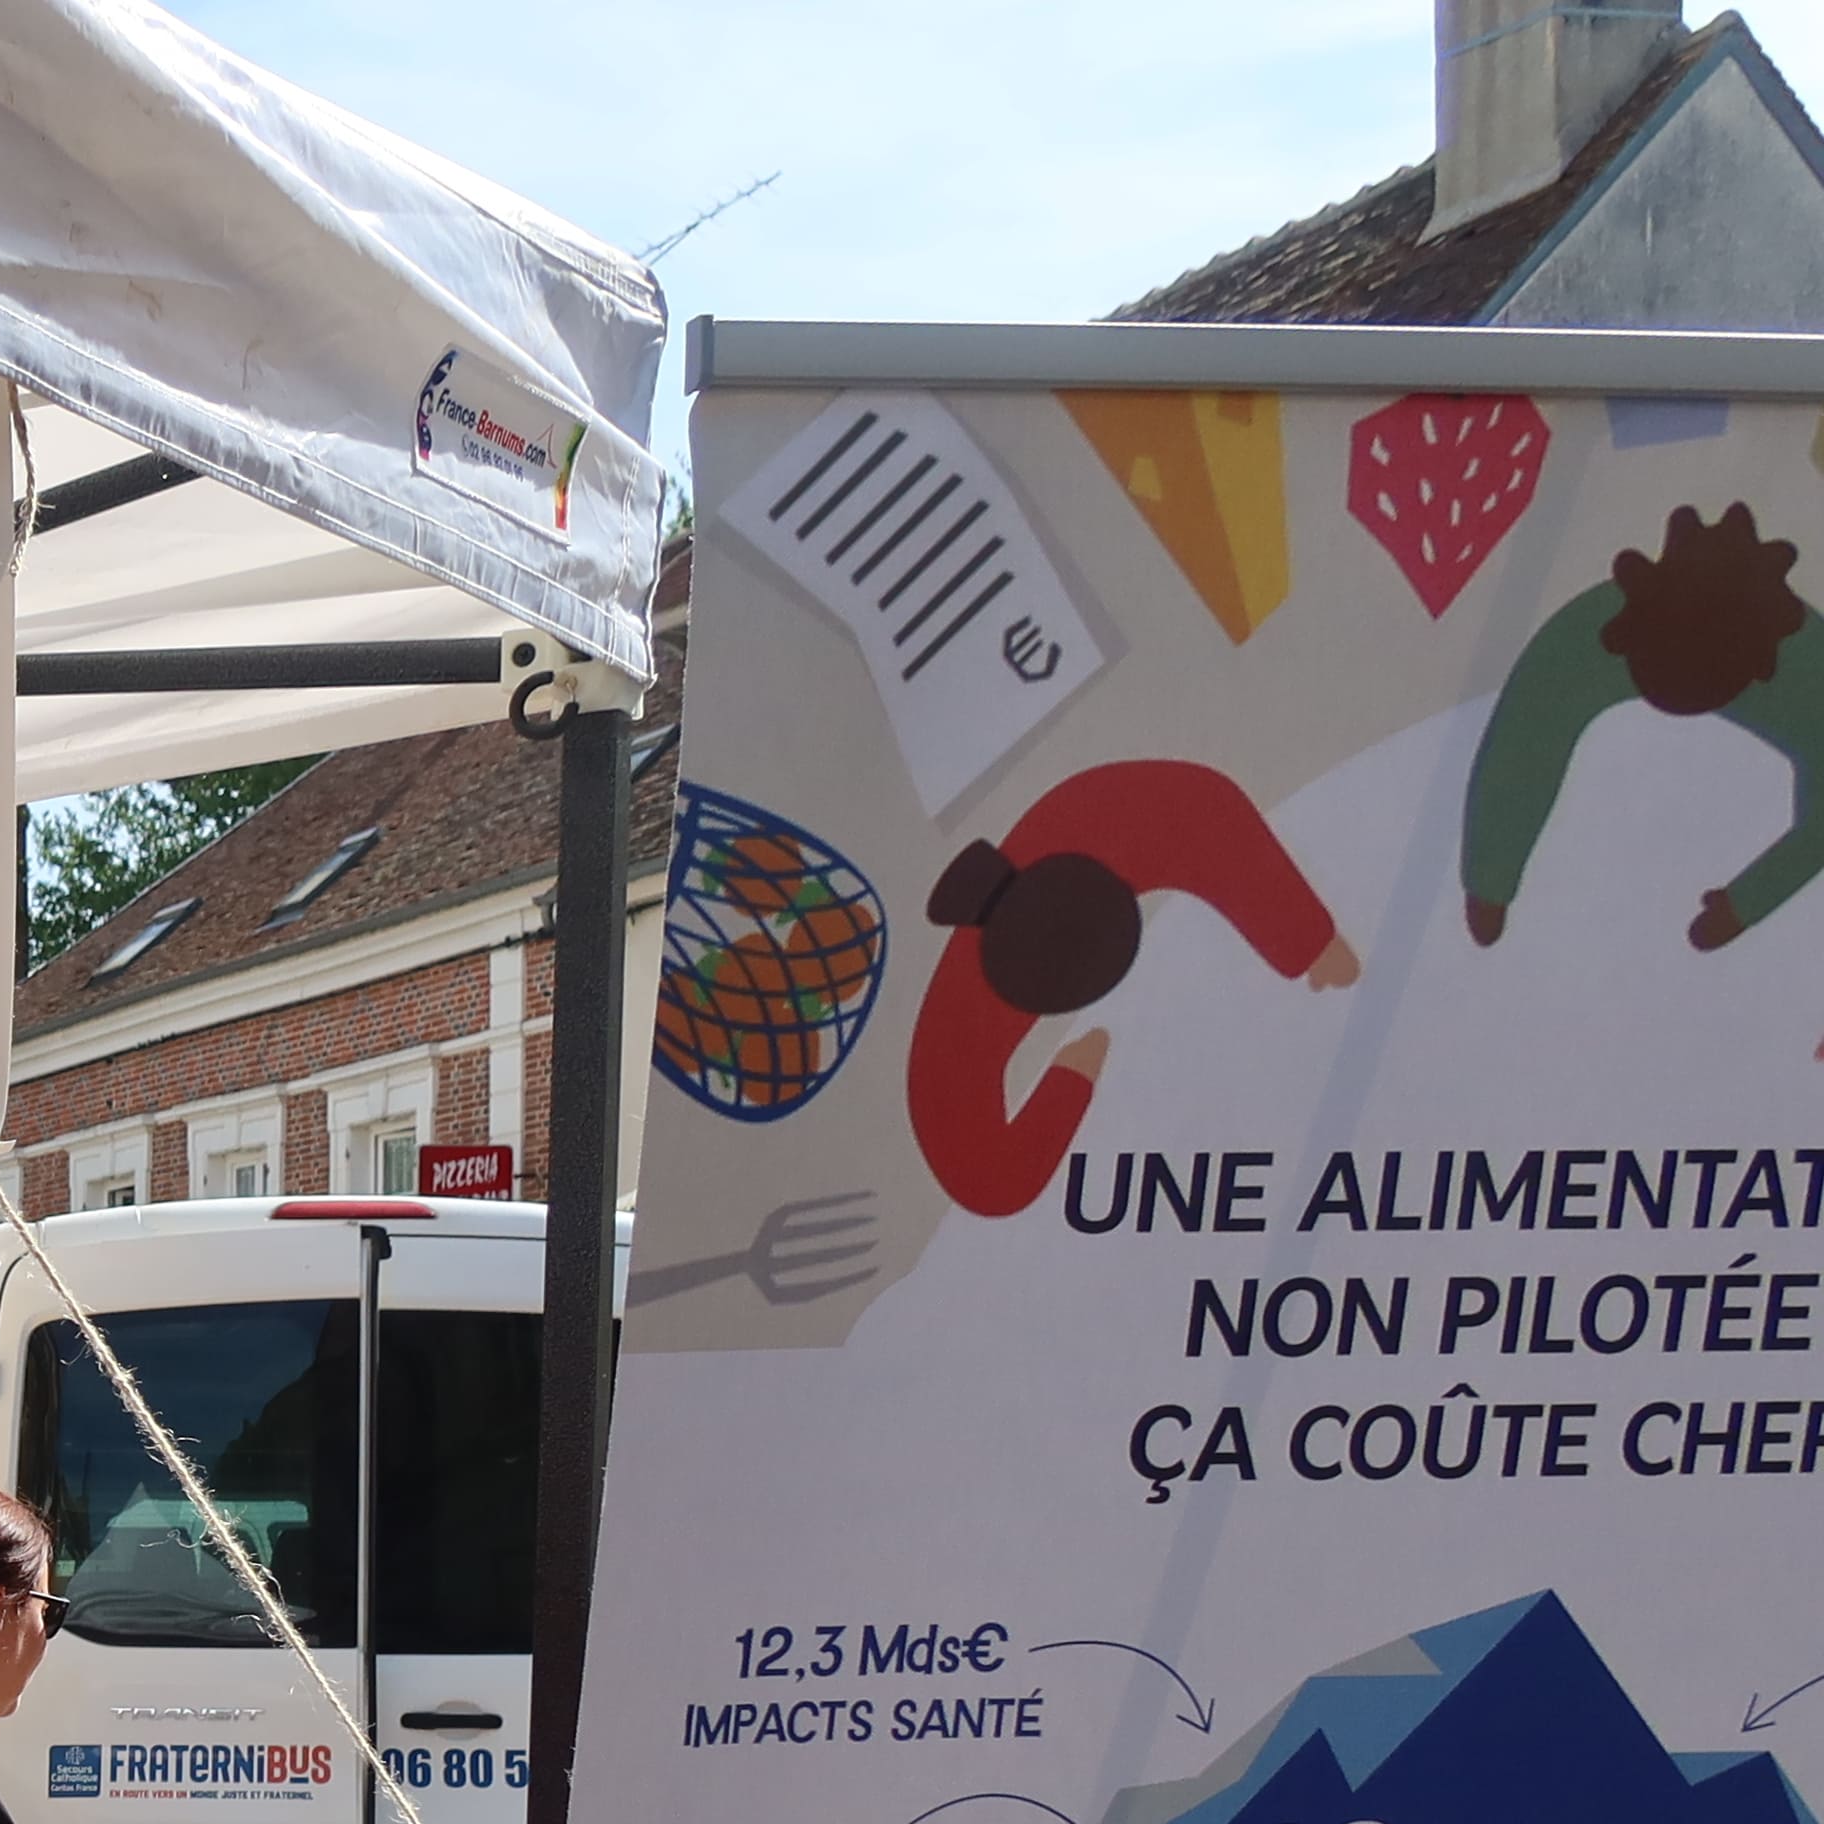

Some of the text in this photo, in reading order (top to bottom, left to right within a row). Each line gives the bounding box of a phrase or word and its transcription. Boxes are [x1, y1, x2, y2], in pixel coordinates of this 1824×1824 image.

[432, 1152, 498, 1192] PIZZERIA
[1065, 1152, 1272, 1233] UNE
[1185, 1253, 1819, 1357] NON PILOTÉE
[1130, 1405, 1256, 1502] ÇA
[1289, 1383, 1596, 1479] COÛTE
[736, 1623, 1008, 1683] 12,3 Mds€
[110, 1707, 263, 1721] TRANSIT
[684, 1688, 1043, 1748] IMPACTS SANTÉ
[51, 1773, 98, 1784] Catholique
[51, 1784, 98, 1792] Caritas France
[57, 1766, 93, 1775] Secours
[382, 1748, 432, 1788] 06
[444, 1748, 493, 1788] 80
[110, 1790, 313, 1800] EN ROUTE VERS UN MONDE JUSTE ET FRATERNEL
